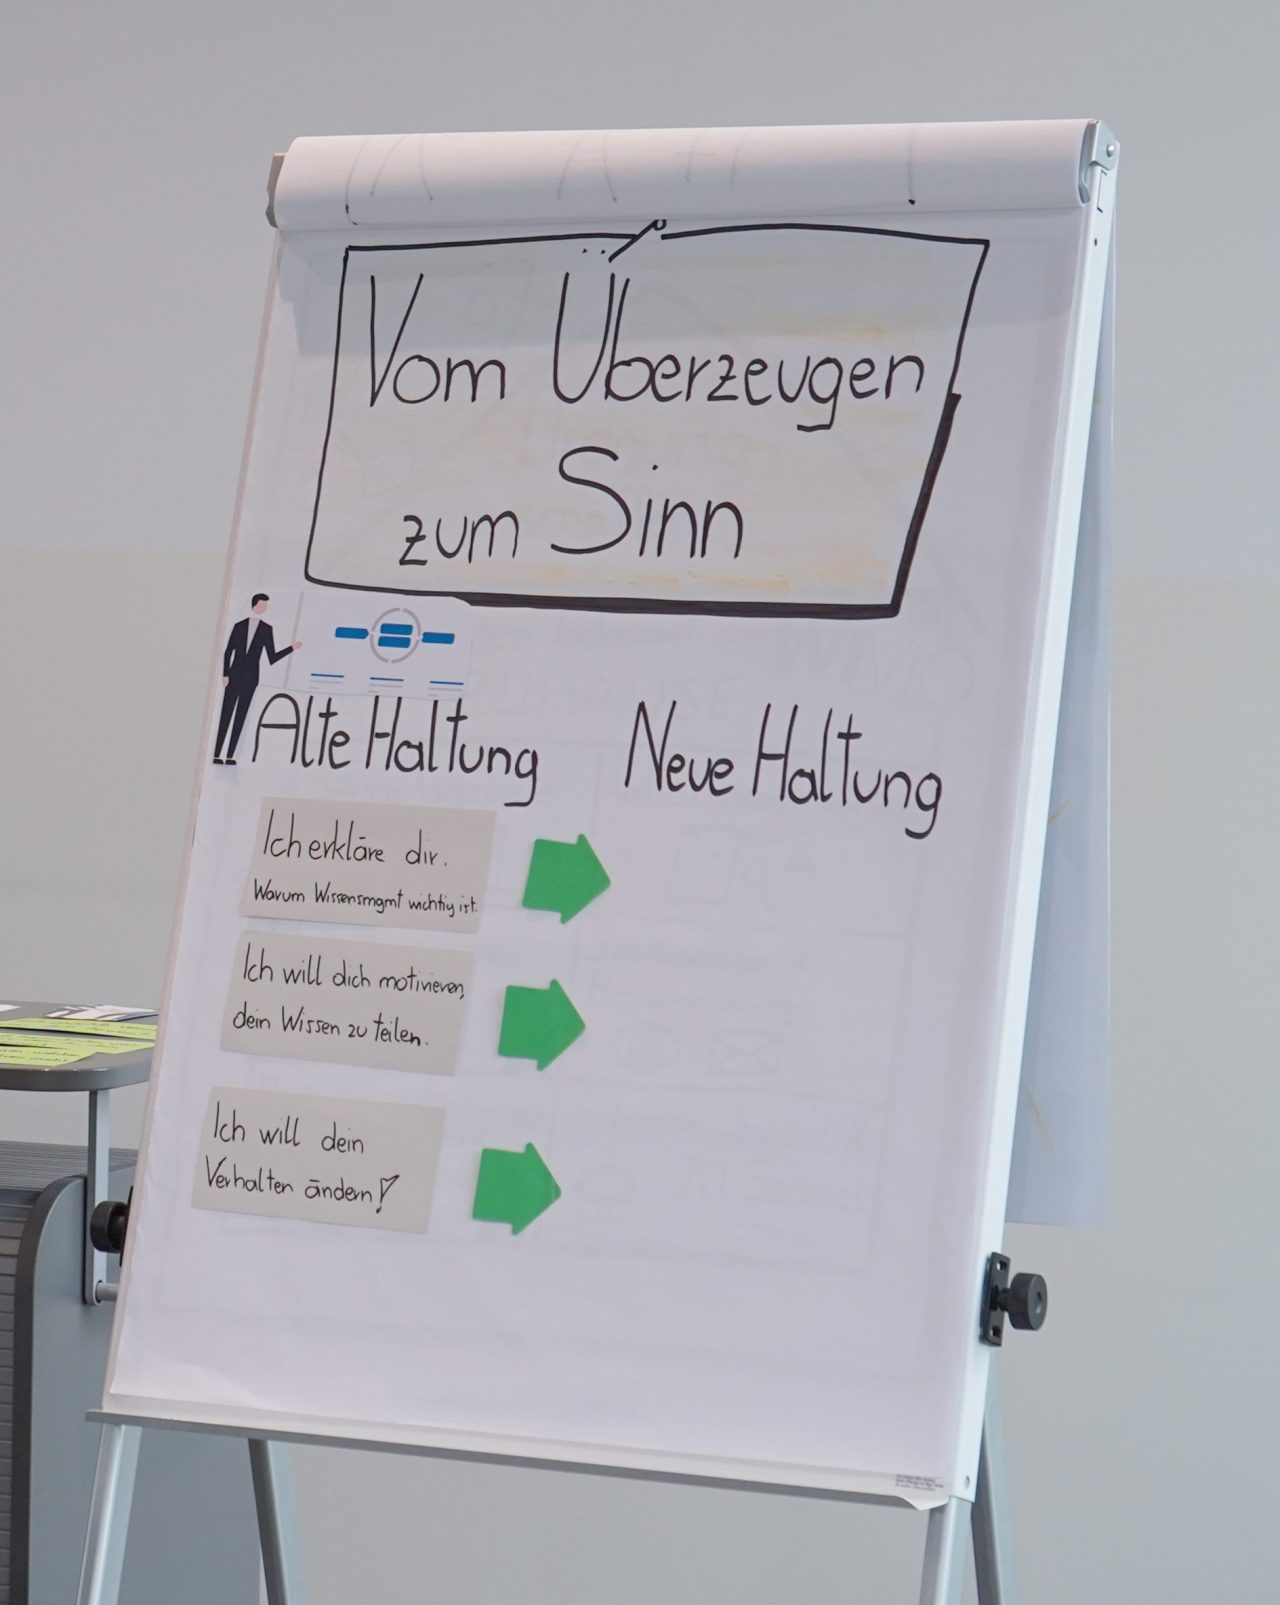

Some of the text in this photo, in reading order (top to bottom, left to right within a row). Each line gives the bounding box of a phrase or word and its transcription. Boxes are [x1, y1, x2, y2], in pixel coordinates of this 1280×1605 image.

[369, 246, 926, 433] Vom Überzeugen
[398, 445, 744, 567] zum Sinn
[249, 689, 352, 771] Alte
[364, 694, 539, 808] Haltung
[623, 699, 943, 841] Neue Haltung
[263, 807, 302, 859] Ich
[253, 877, 306, 903] Warum
[407, 892, 456, 919] wichtig
[242, 941, 274, 983] Ich
[282, 953, 323, 987] will
[331, 959, 371, 989] dich
[232, 1000, 429, 1048] dein Wissen zu teilen.
[213, 1100, 365, 1155] Ich will dein
[205, 1154, 294, 1195] Verhalten
